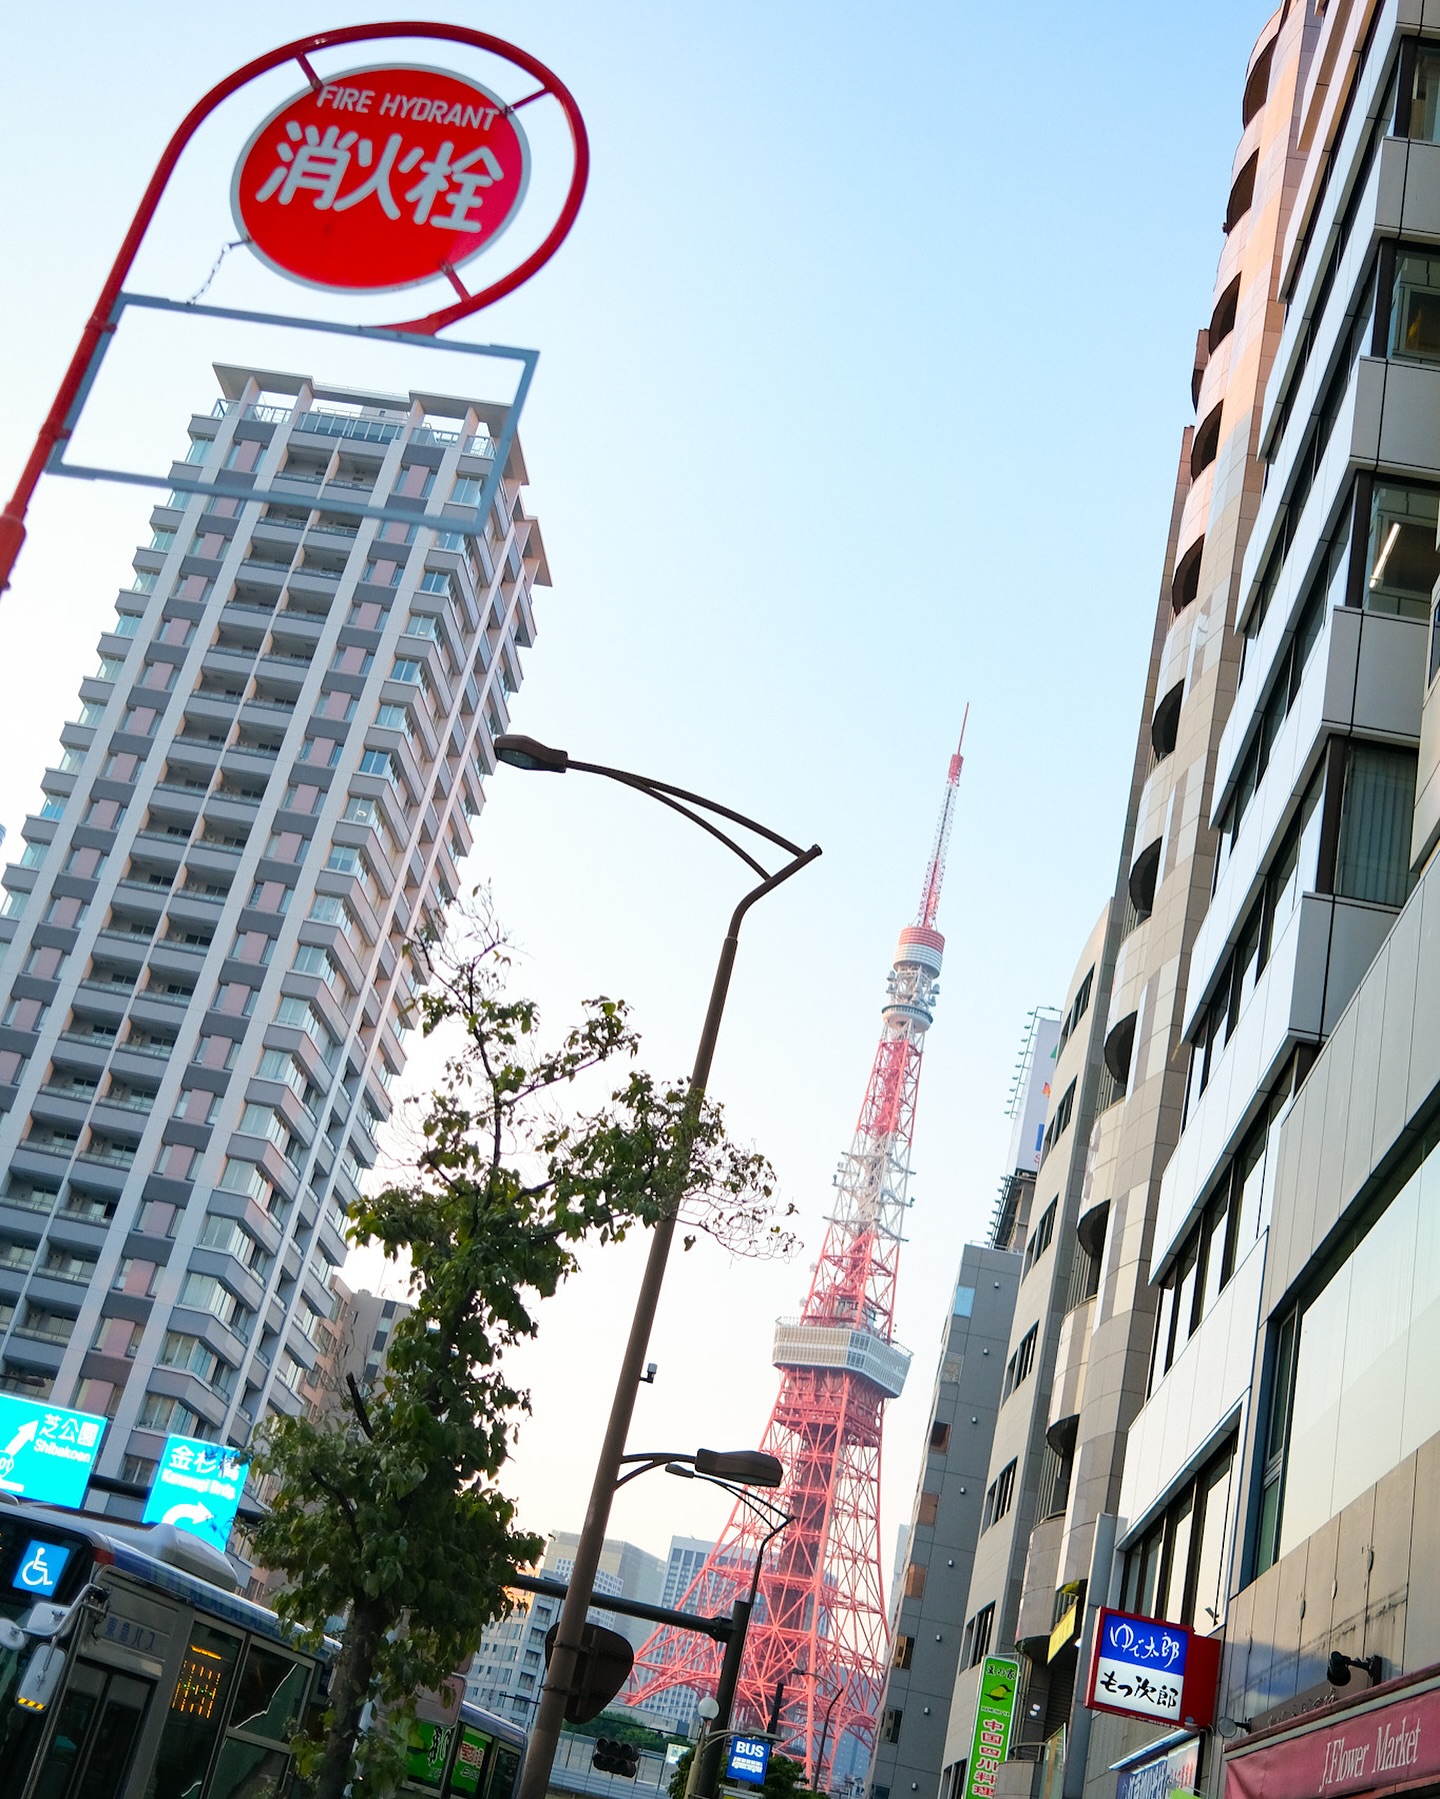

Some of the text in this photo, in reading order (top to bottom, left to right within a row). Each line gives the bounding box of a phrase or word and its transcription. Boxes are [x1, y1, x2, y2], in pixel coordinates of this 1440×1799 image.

[316, 85, 500, 132] FIRE HYDRANT
[255, 120, 505, 233] 消火栓
[1109, 1622, 1180, 1669] ゆで太郎
[1100, 1670, 1179, 1709] もつ次郎
[735, 1740, 765, 1759] BUS
[1318, 1715, 1422, 1793] J.Flower Market
